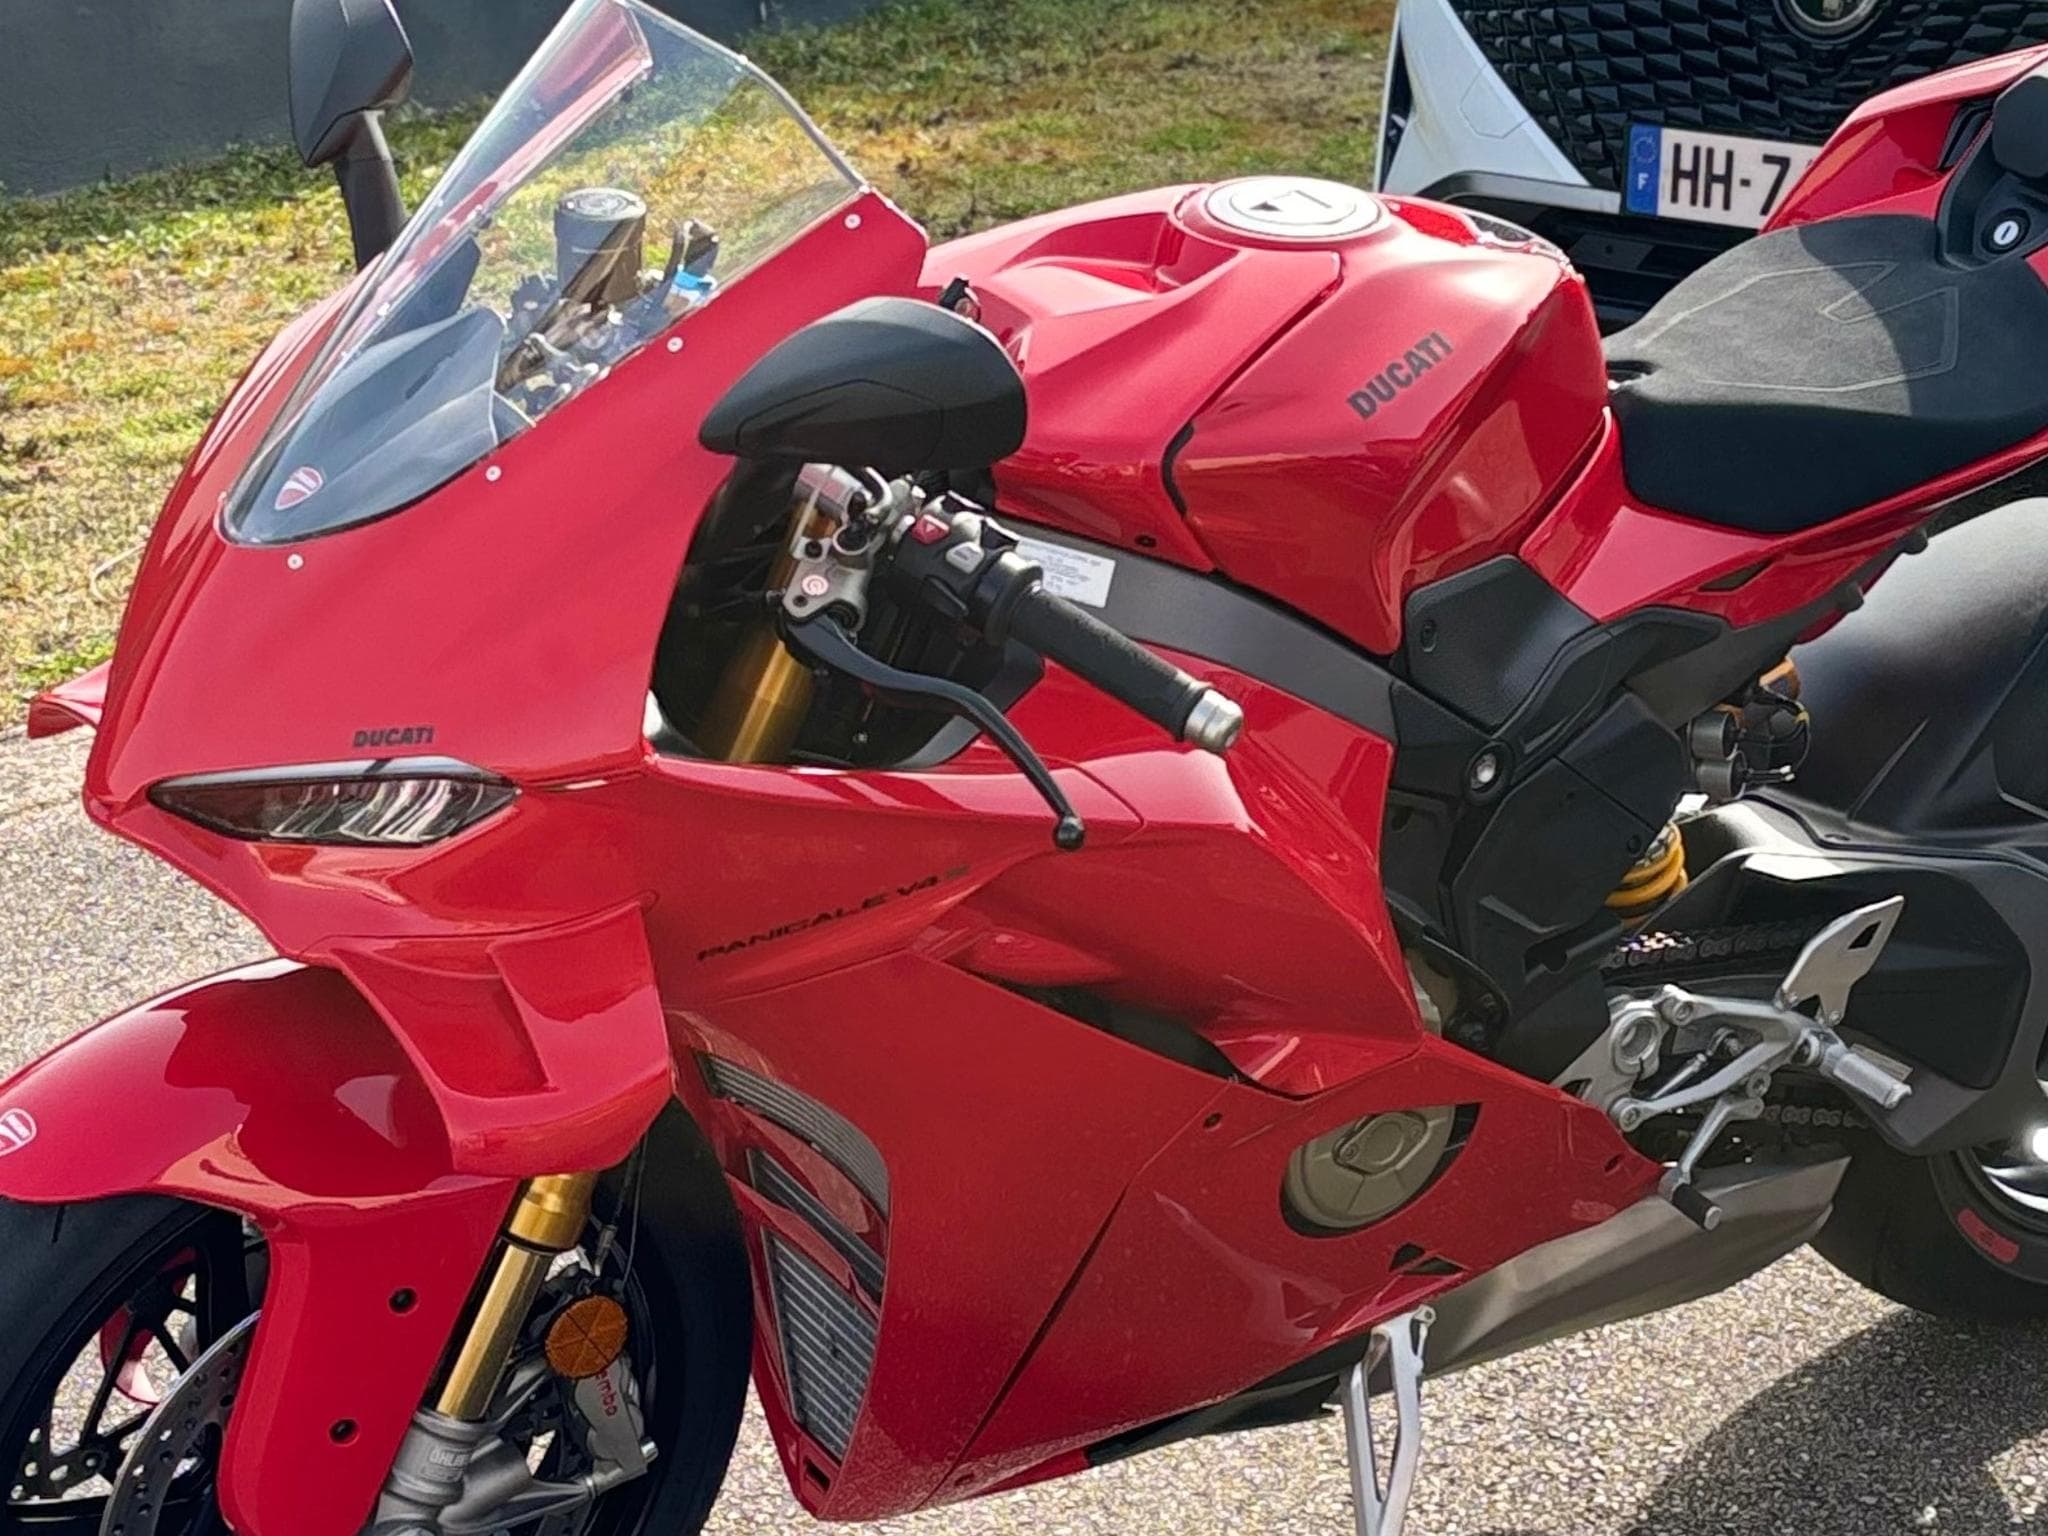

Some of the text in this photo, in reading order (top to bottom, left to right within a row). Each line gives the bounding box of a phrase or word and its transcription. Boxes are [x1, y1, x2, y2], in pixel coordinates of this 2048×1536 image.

[1637, 172, 1649, 190] F
[1670, 142, 1813, 216] HH-7
[1346, 331, 1454, 420] DUCATI
[353, 726, 434, 748] DUCATI
